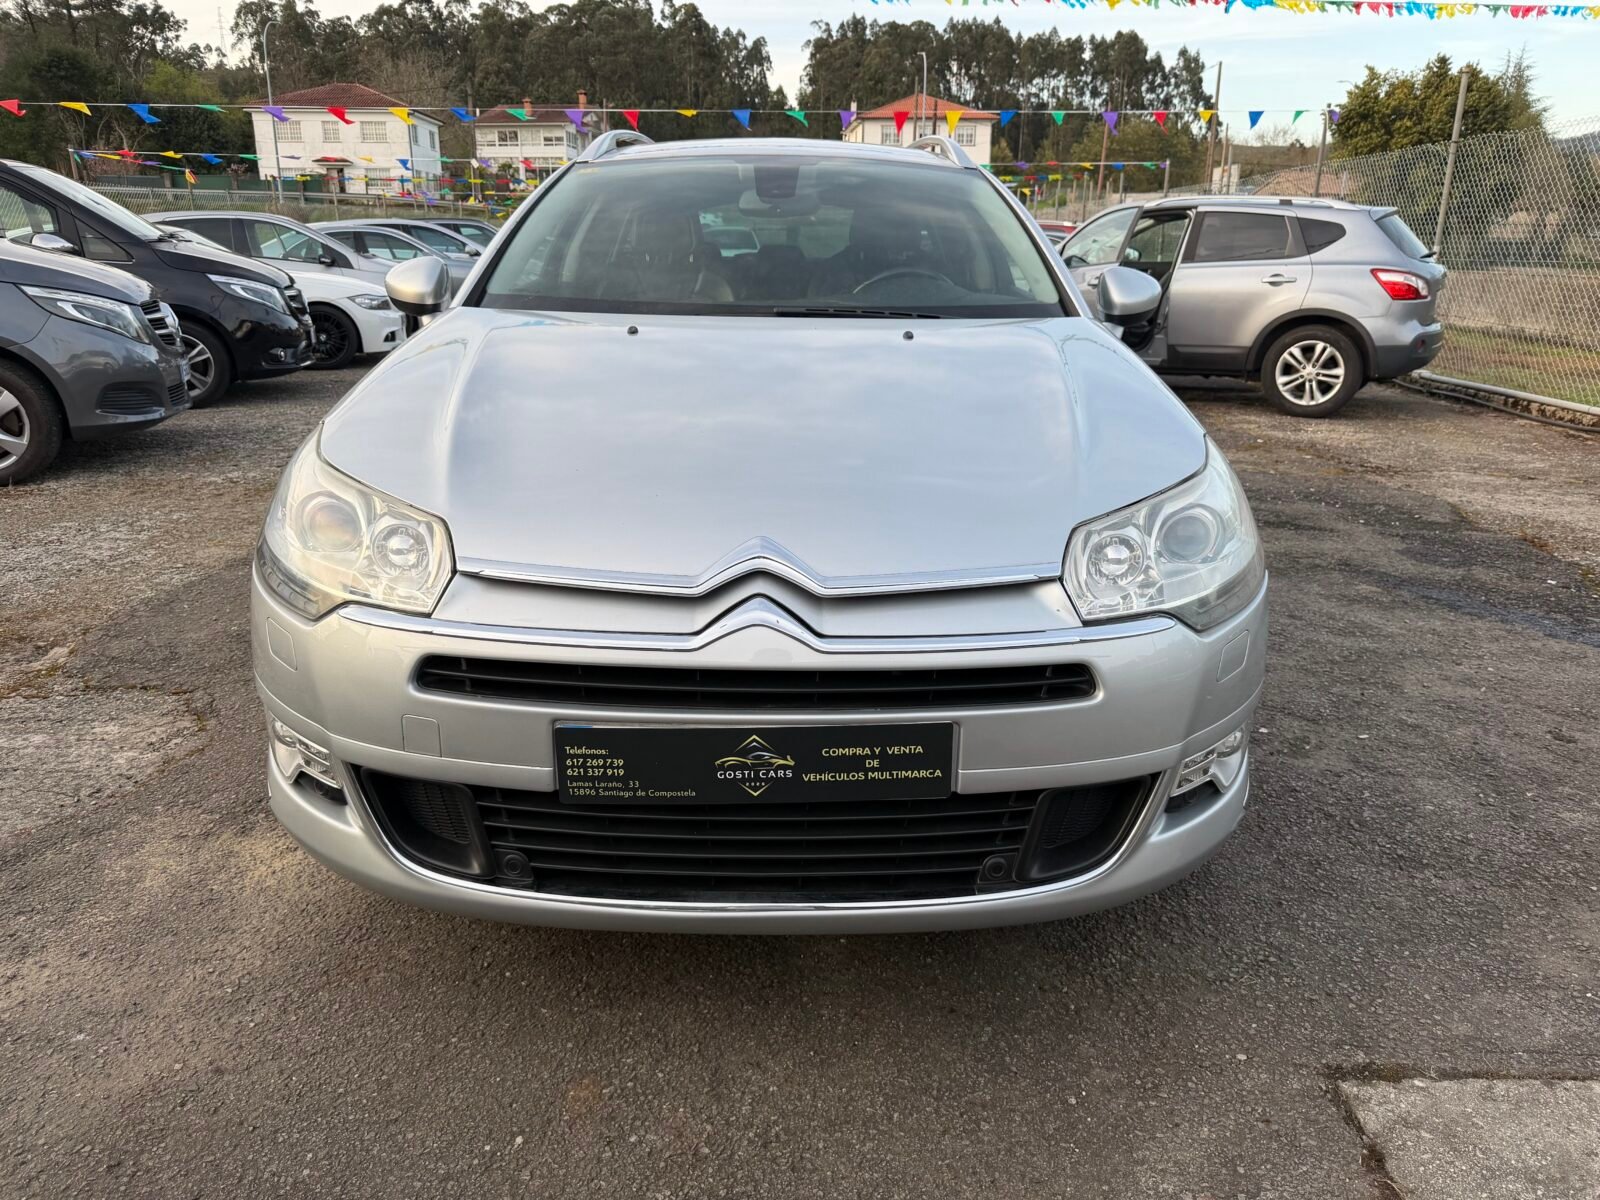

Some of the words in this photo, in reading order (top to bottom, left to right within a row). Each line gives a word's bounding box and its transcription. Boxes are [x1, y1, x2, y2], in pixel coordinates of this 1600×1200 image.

[822, 747, 871, 757] COMPRA
[873, 747, 881, 755] Y
[887, 745, 924, 755] VENTA
[566, 758, 583, 766] 617
[586, 758, 604, 766] 269
[606, 758, 624, 767] 739
[865, 759, 880, 768] DE
[566, 768, 584, 776] 621
[587, 768, 604, 776] 337
[606, 768, 625, 777] 919
[717, 770, 754, 779] GOSTI
[759, 770, 793, 779] CARS
[802, 771, 865, 782] VEHÍCULOS
[868, 769, 942, 780] MULTIMARCA
[629, 780, 640, 788] 33
[569, 788, 596, 796] 15896
[599, 788, 634, 798] Santiago
[636, 789, 646, 797] de
[648, 789, 696, 798] Compostela
